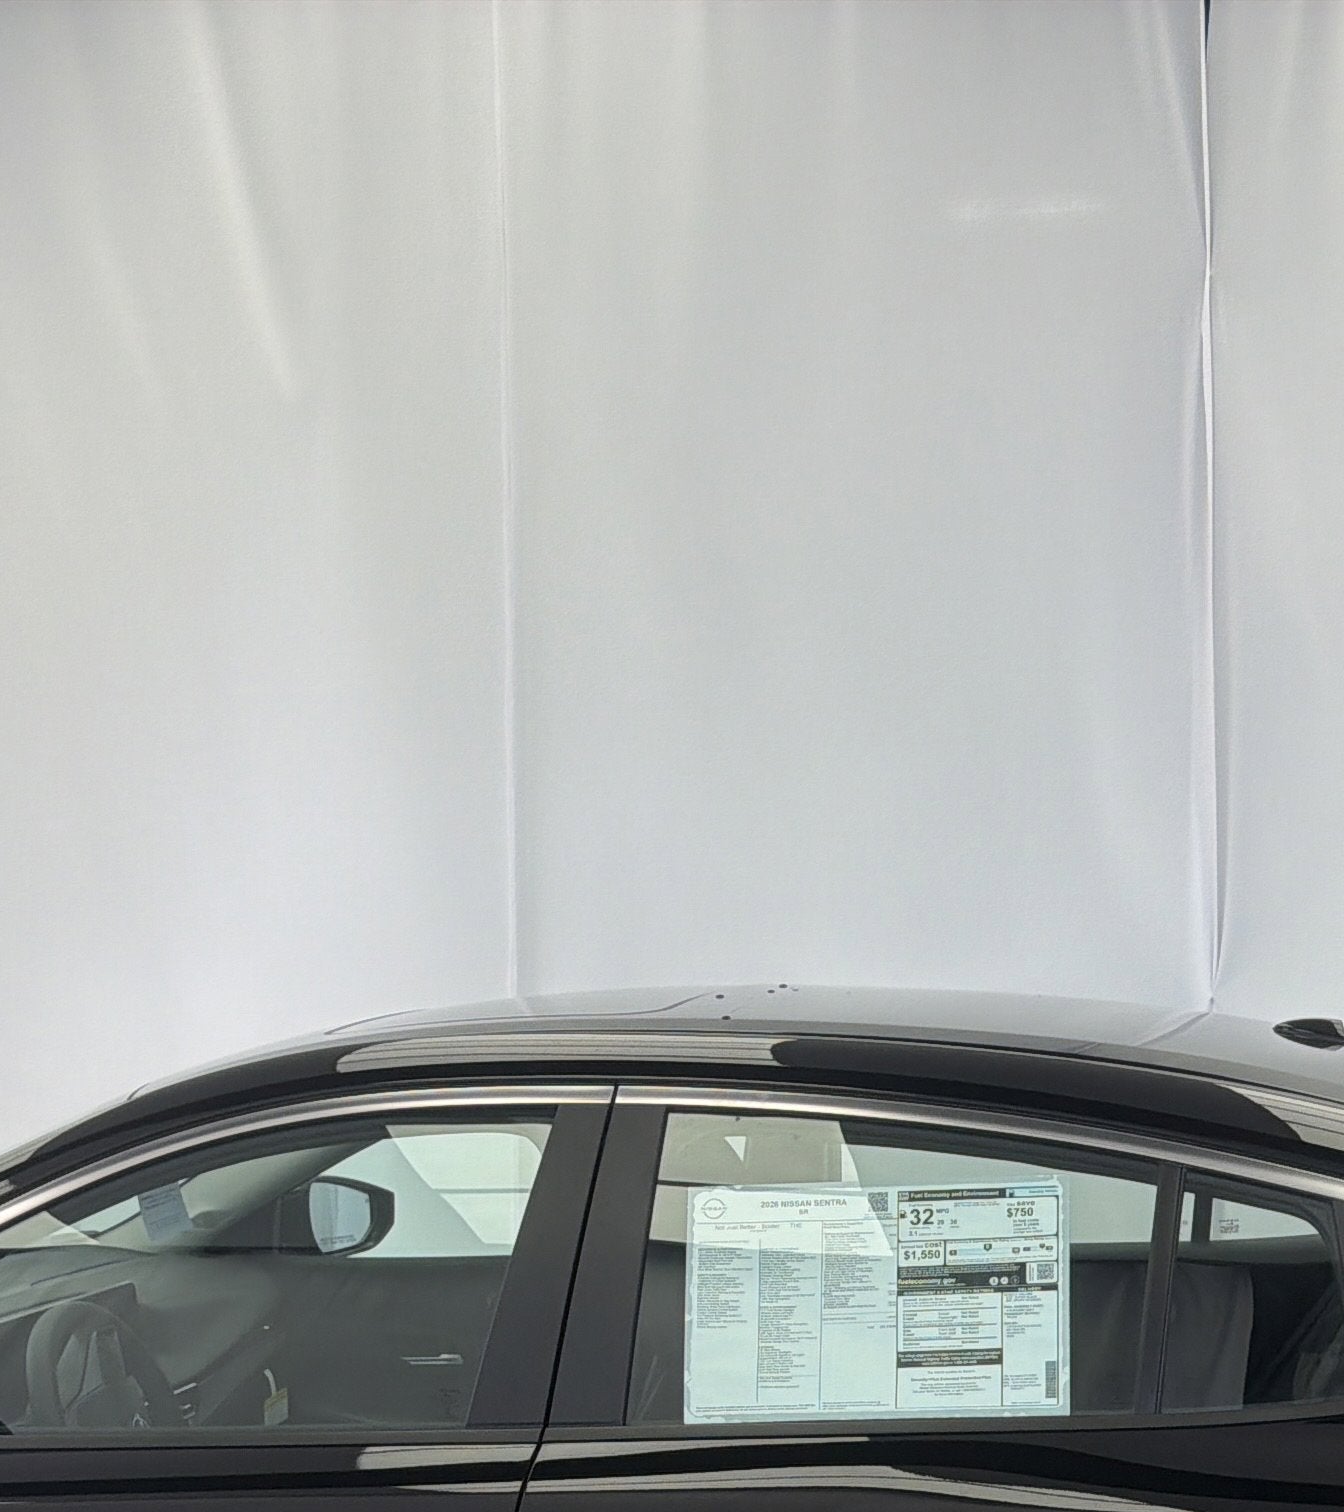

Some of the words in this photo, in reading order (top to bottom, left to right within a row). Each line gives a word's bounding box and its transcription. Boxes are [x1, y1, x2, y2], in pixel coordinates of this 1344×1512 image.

[781, 1200, 812, 1208] NISSAN
[813, 1199, 847, 1207] SENTRA
[909, 1208, 935, 1226] 32
[1006, 1207, 1034, 1218] $750
[903, 1250, 941, 1261] $1,550
